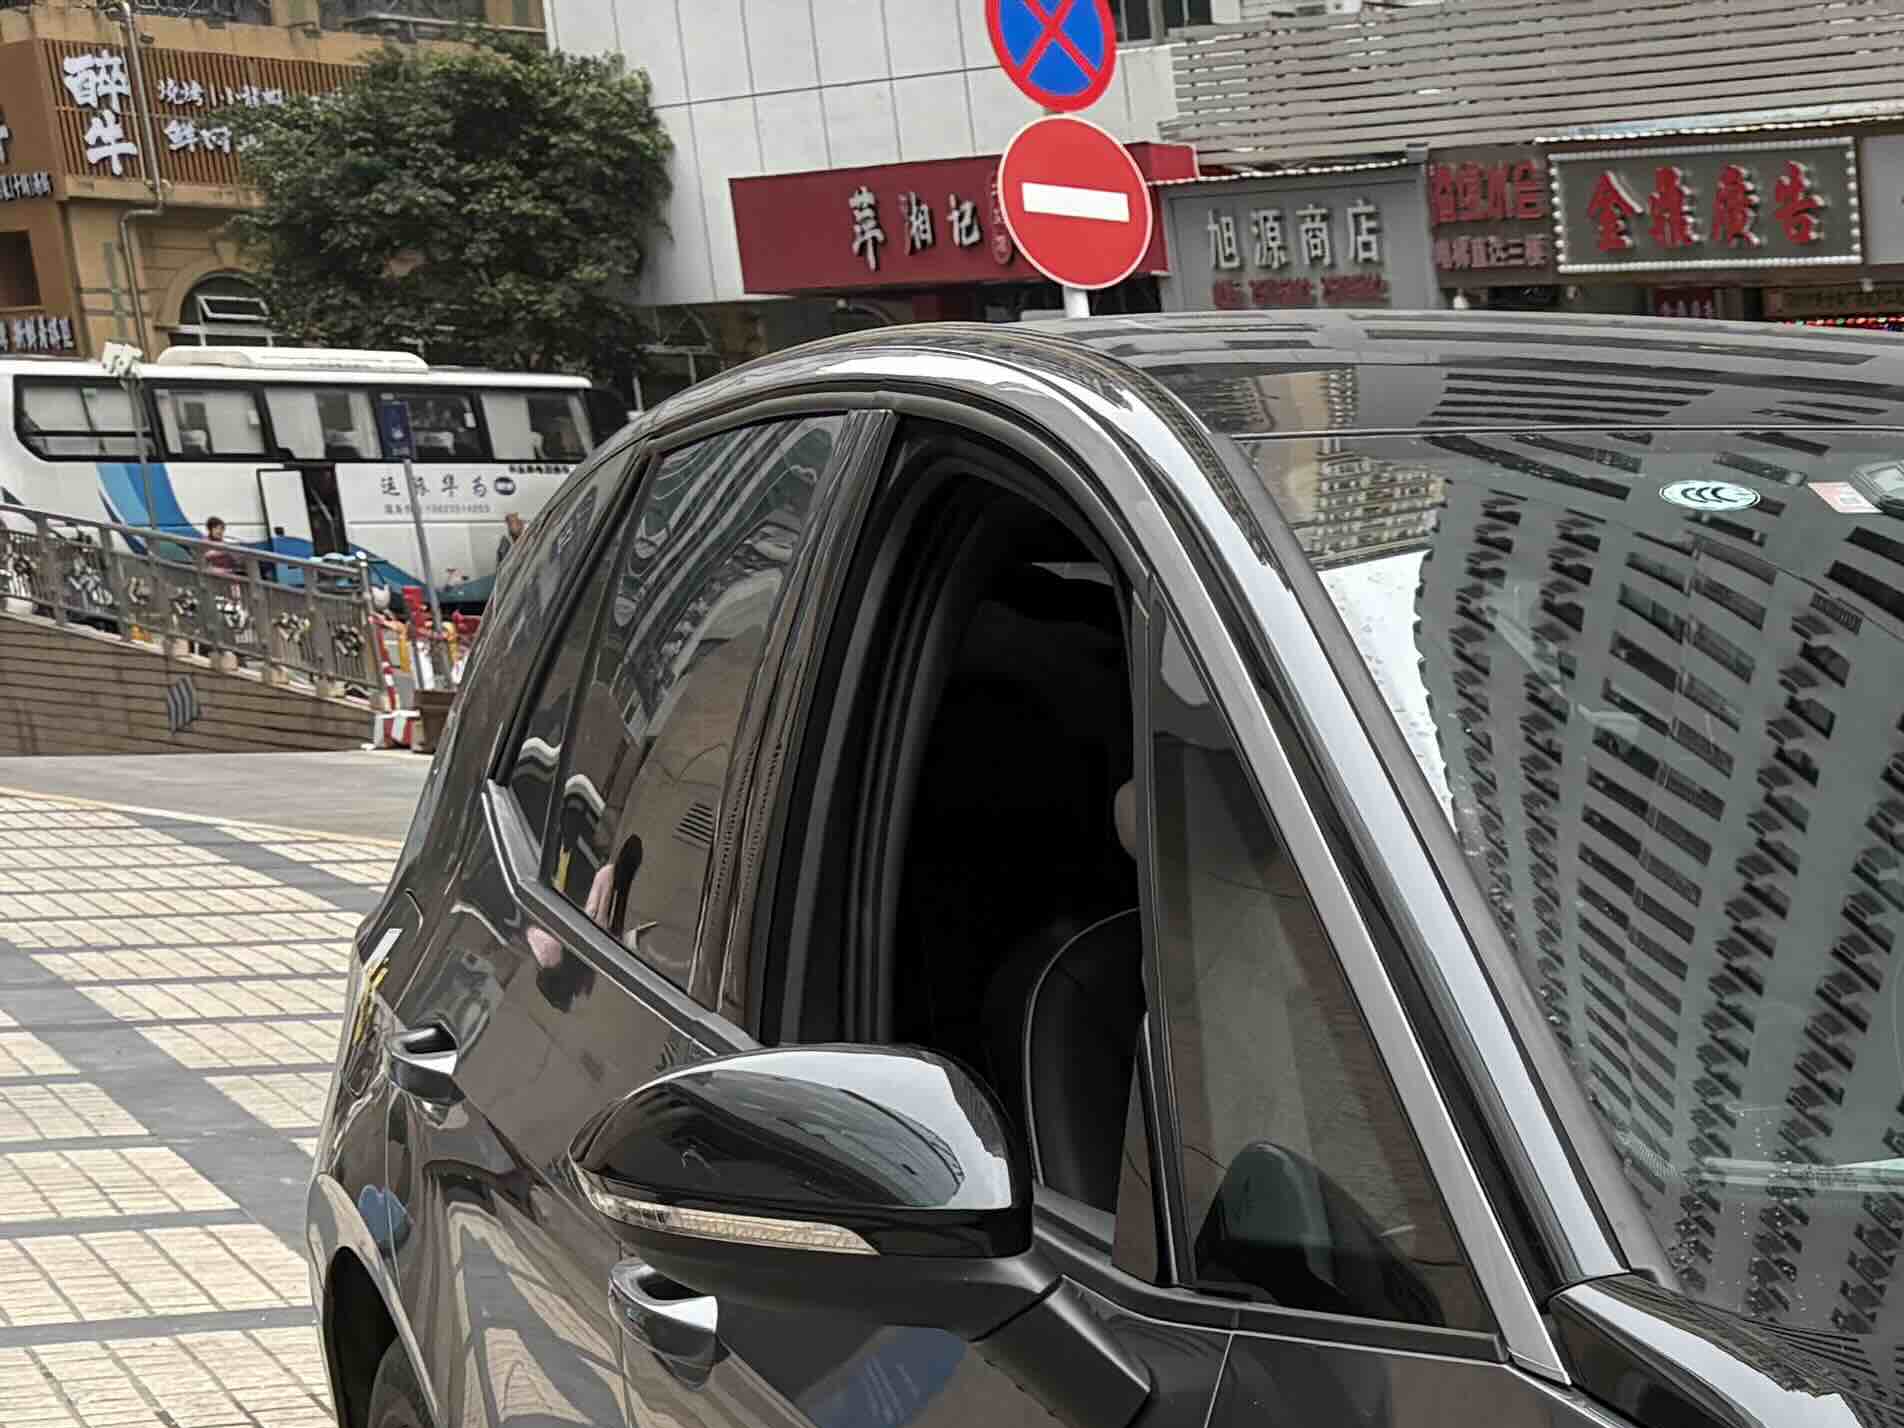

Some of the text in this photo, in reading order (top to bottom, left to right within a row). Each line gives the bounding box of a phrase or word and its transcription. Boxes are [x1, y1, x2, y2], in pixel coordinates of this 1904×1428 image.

[63, 50, 138, 176] 醉牛
[1207, 199, 1380, 269] 旭源商店
